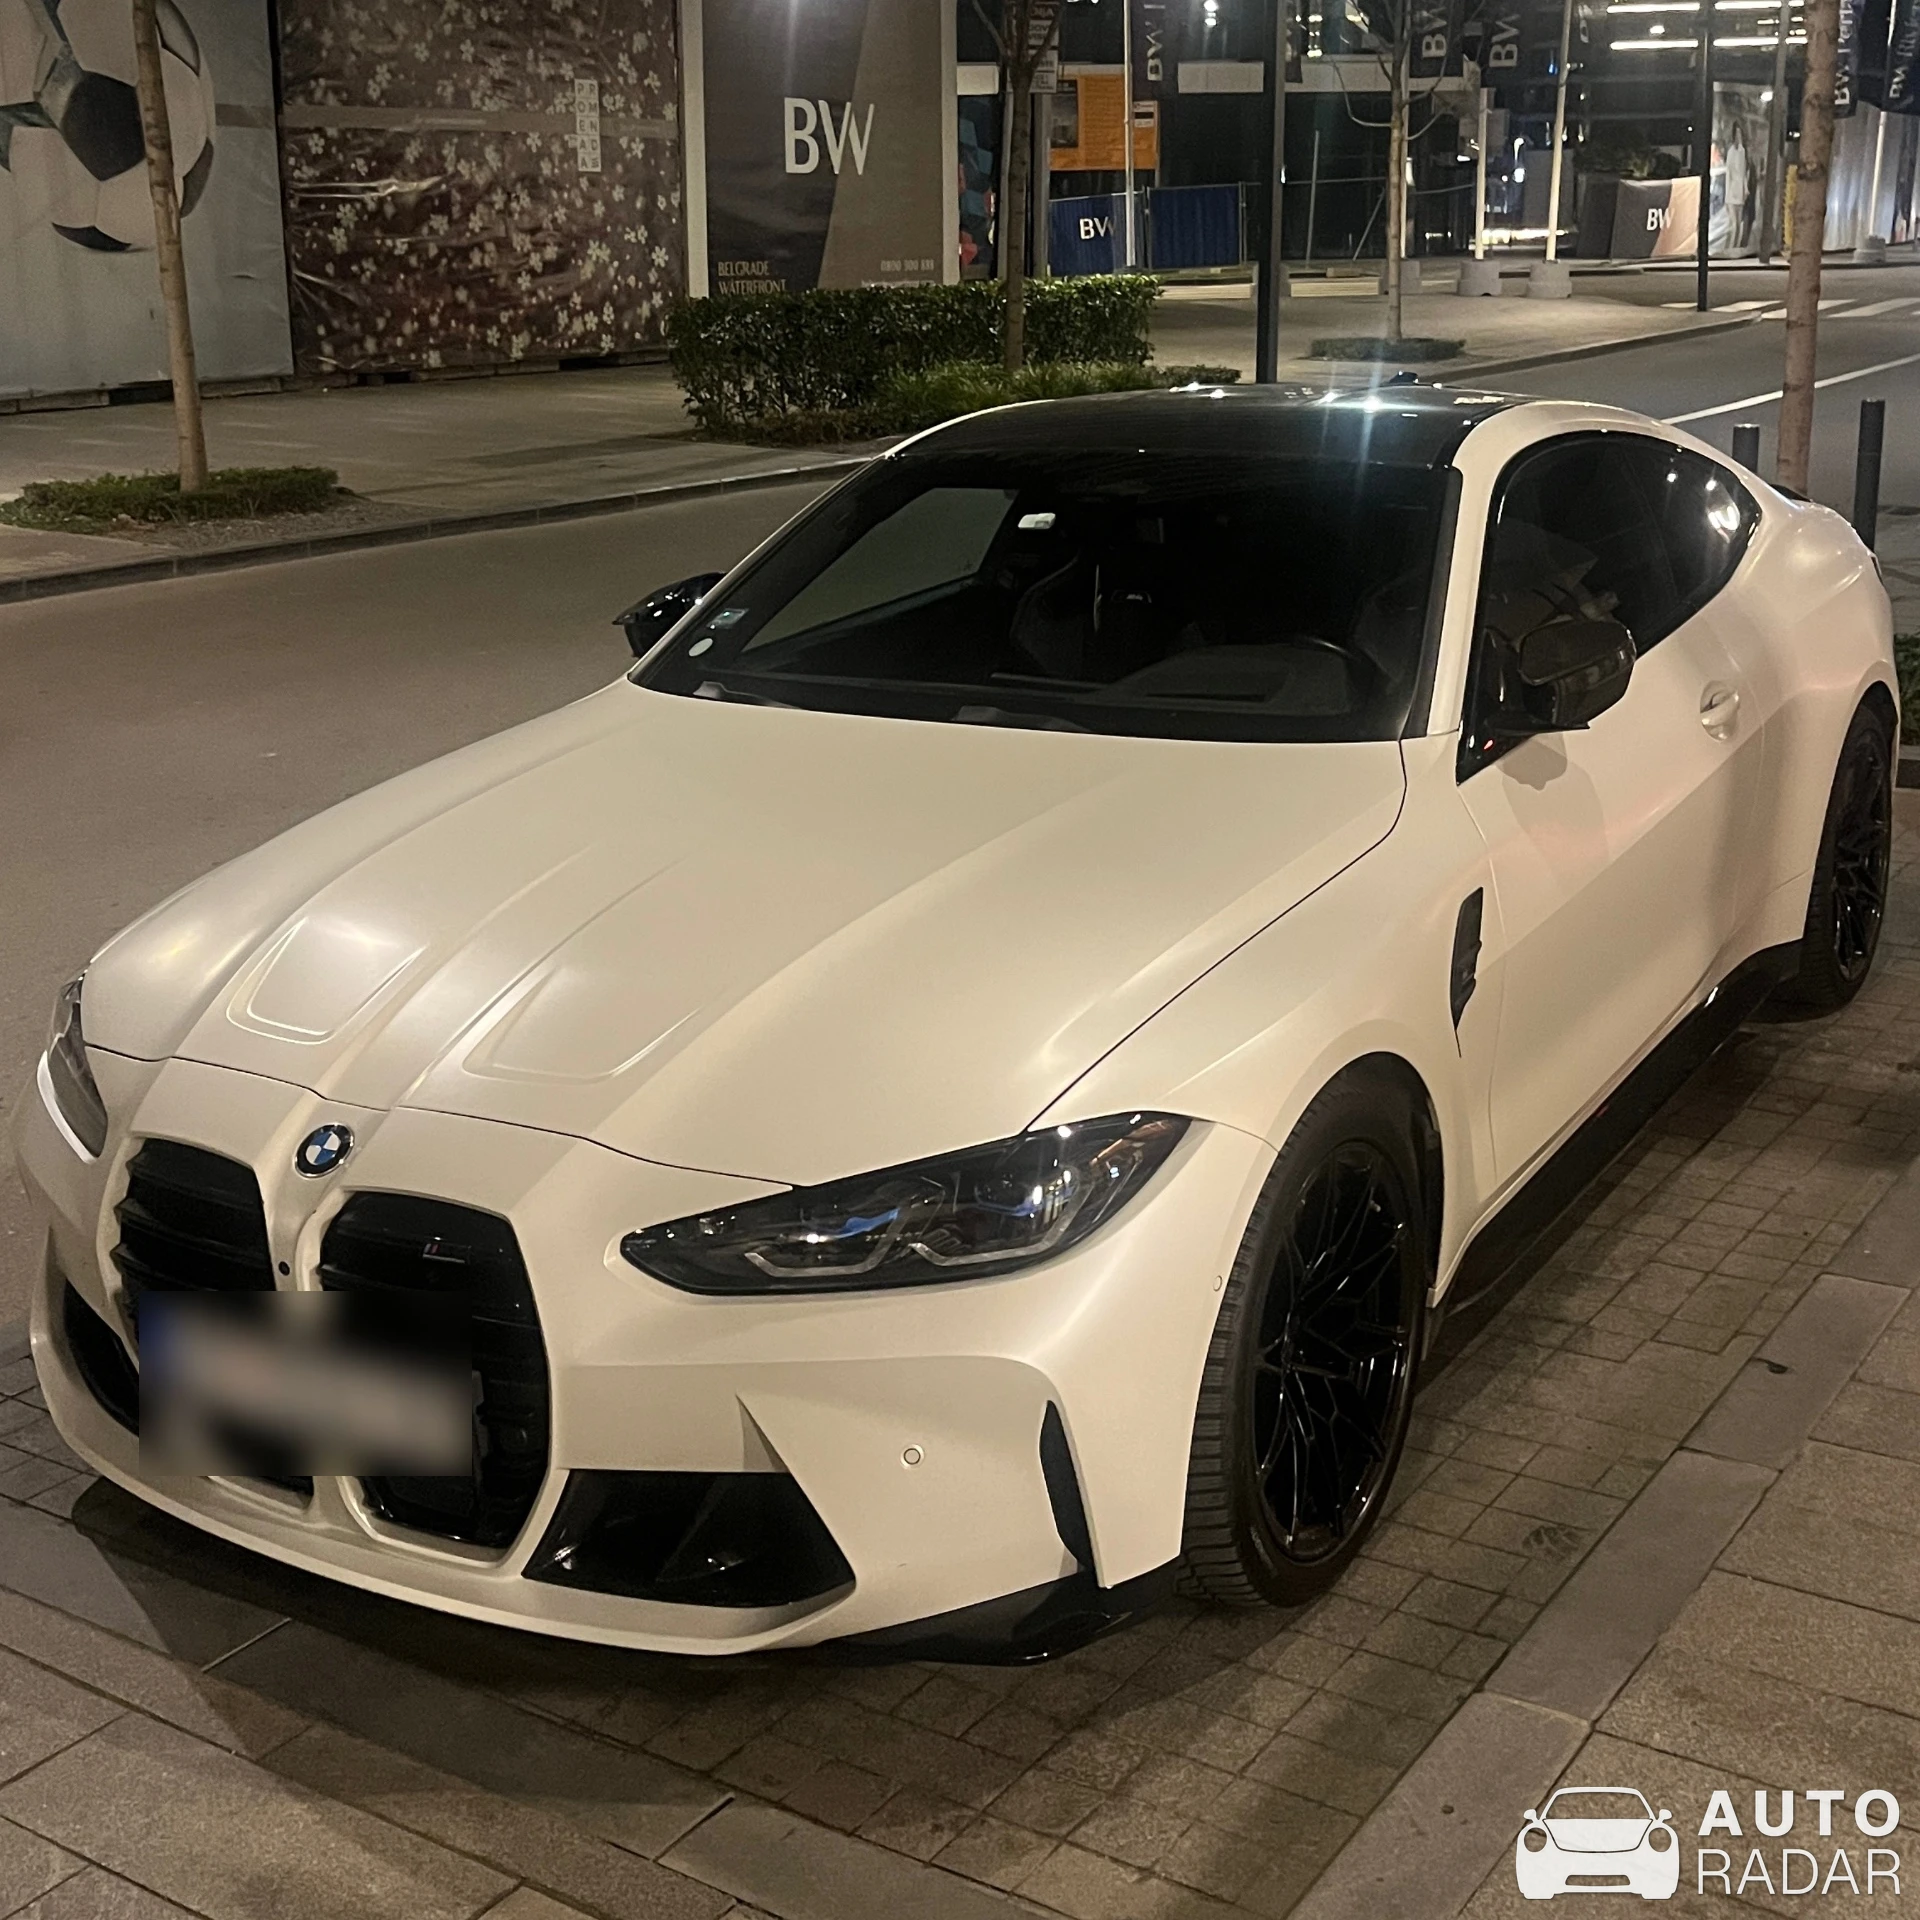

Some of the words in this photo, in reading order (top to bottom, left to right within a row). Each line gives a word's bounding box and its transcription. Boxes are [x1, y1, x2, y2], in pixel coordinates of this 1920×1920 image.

[784, 97, 875, 175] BW
[1079, 216, 1117, 240] BW
[1646, 208, 1676, 231] BW
[718, 260, 770, 277] BELGRADE
[718, 278, 788, 296] WATERFRONT
